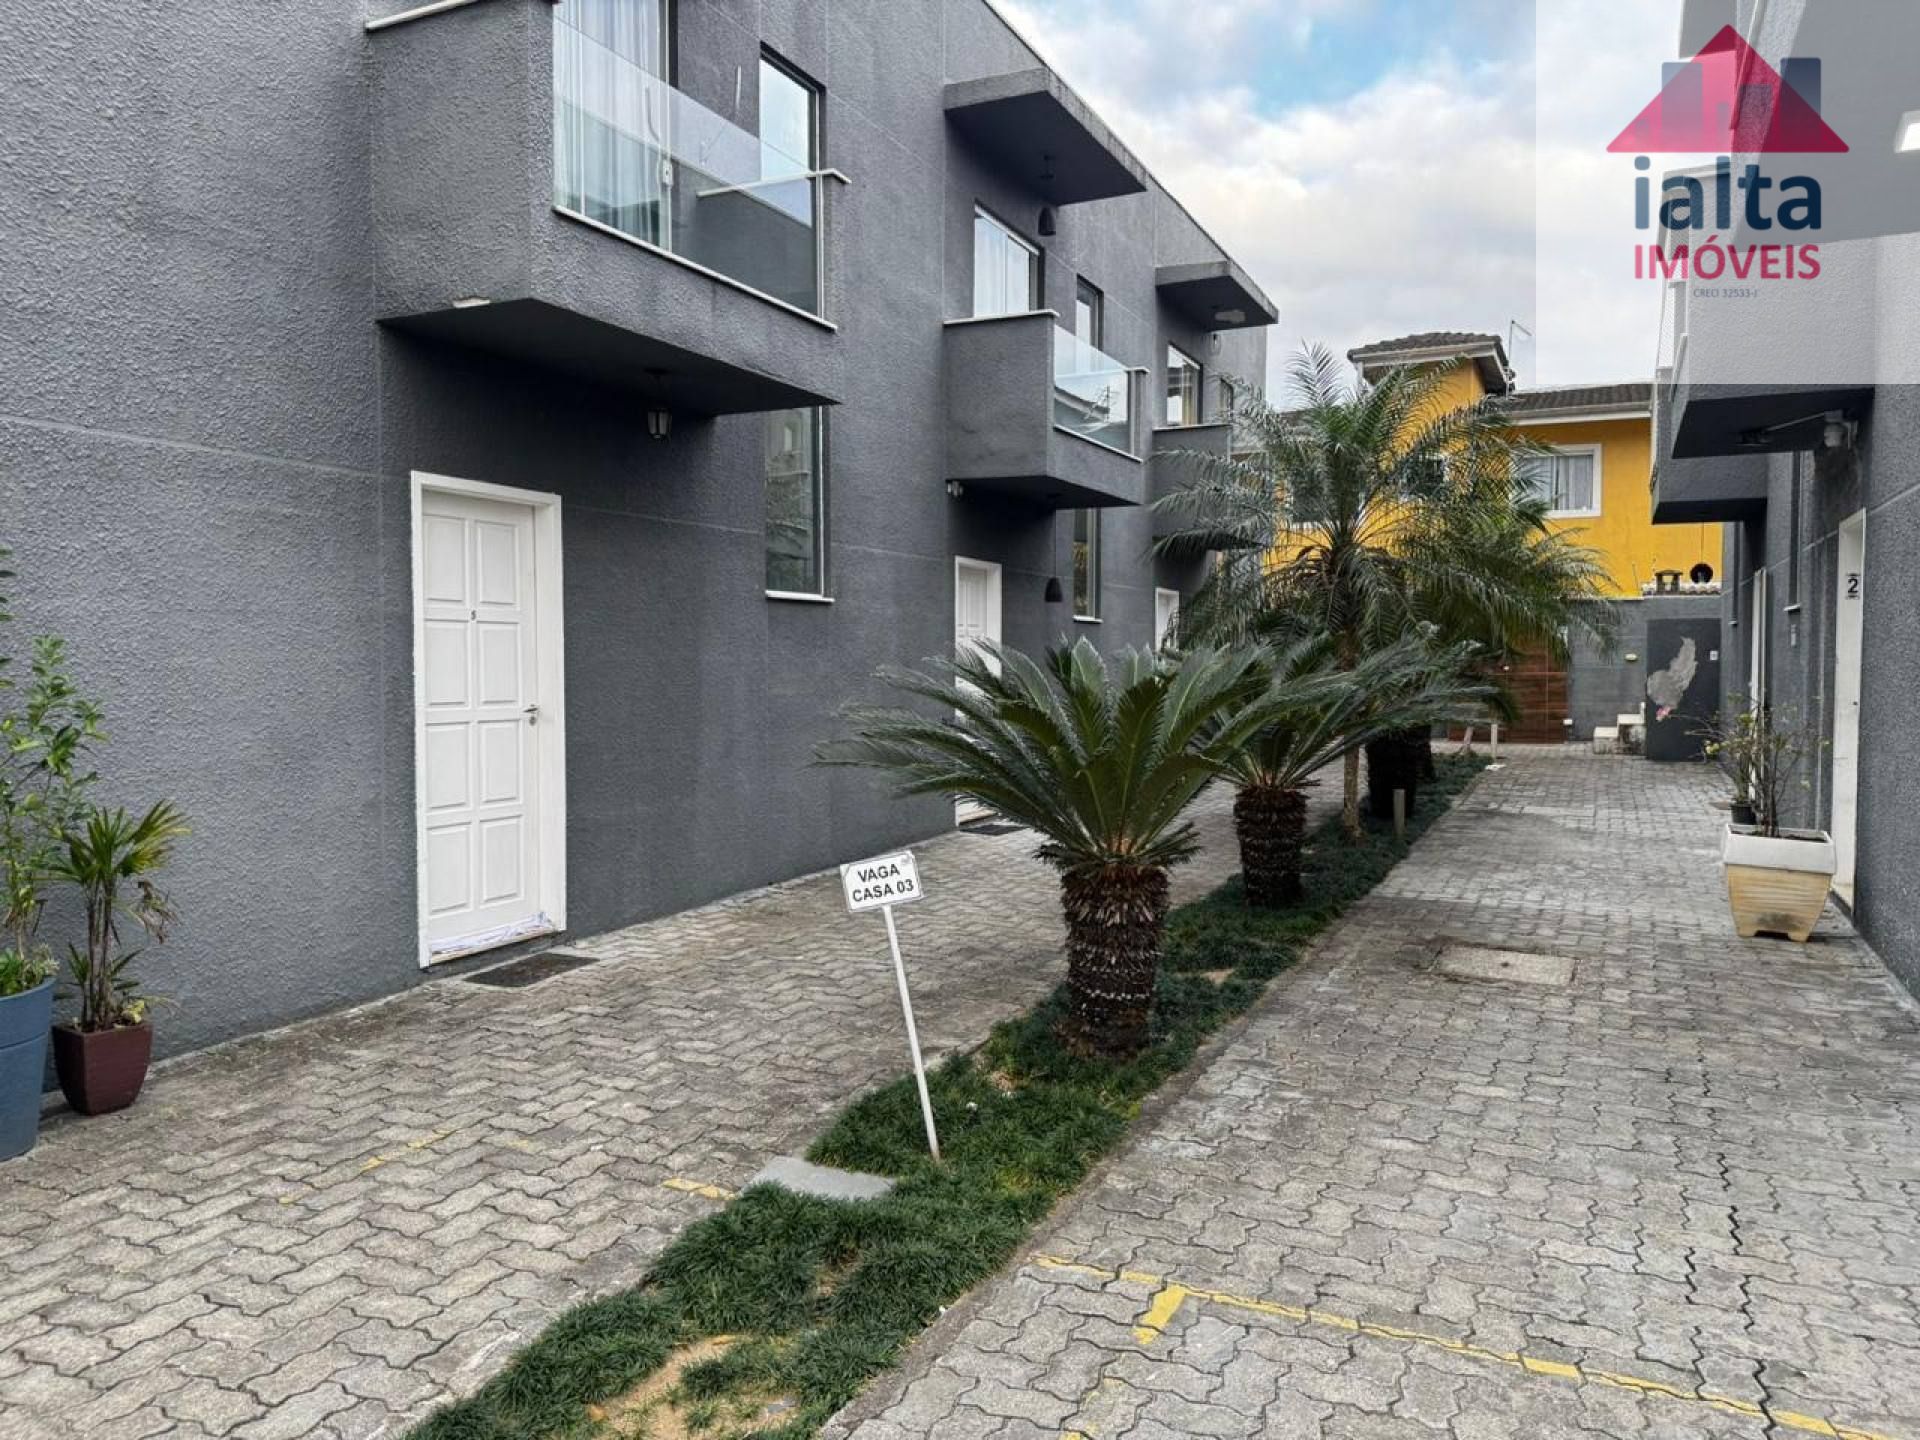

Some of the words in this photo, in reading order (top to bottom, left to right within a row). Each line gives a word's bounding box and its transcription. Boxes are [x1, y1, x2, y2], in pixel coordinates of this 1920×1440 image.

[1847, 578, 1859, 594] 2
[857, 863, 901, 883] VAGA
[852, 883, 895, 902] CASA
[896, 878, 914, 893] 03
